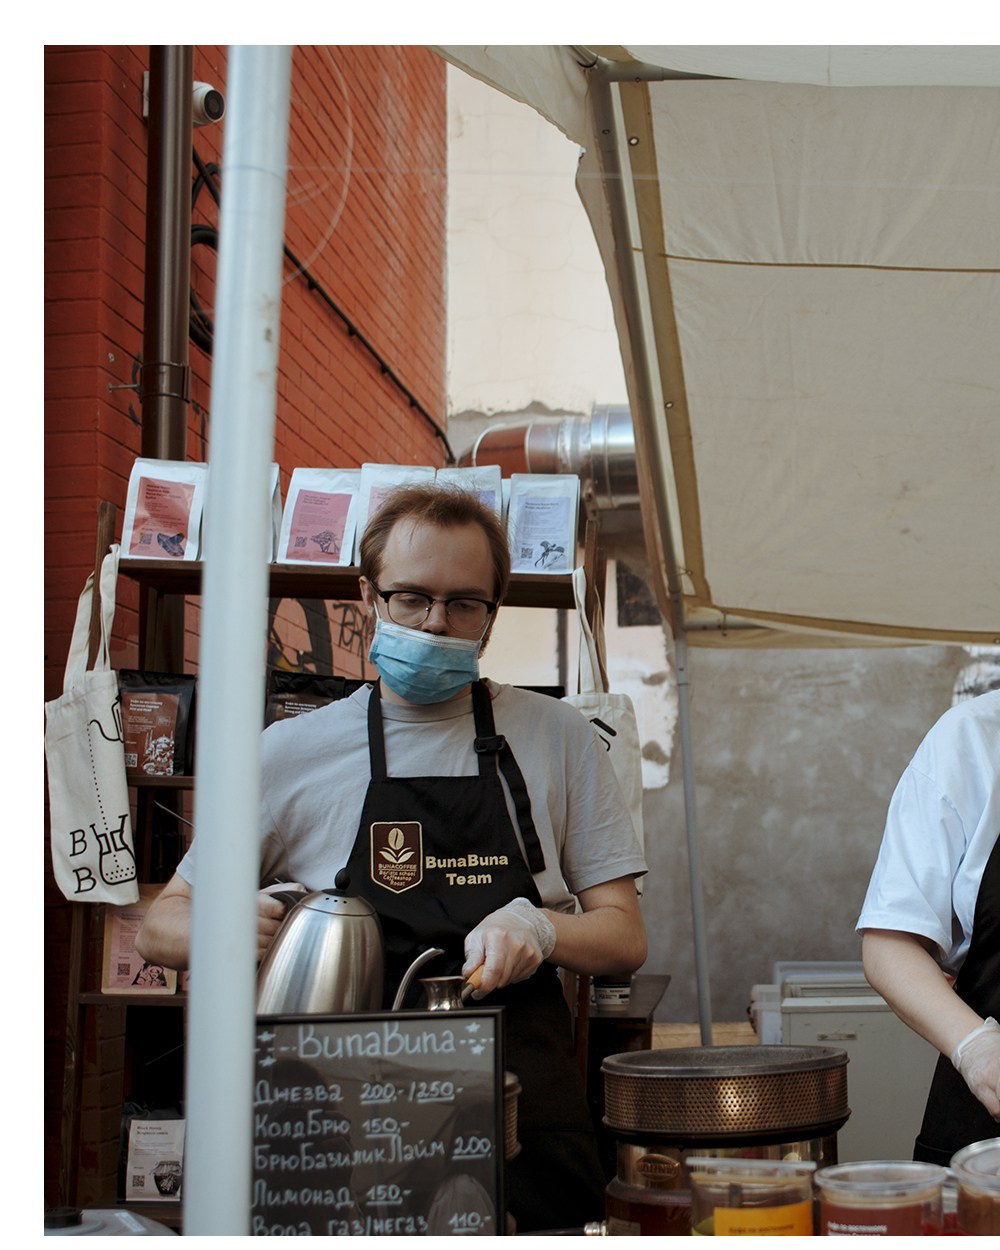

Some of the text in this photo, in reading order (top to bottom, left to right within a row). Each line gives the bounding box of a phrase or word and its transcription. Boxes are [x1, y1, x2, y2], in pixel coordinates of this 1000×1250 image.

[425, 853, 509, 869] BunaBuna
[446, 873, 493, 886] Team
[298, 1021, 457, 1059] BunaBuna
